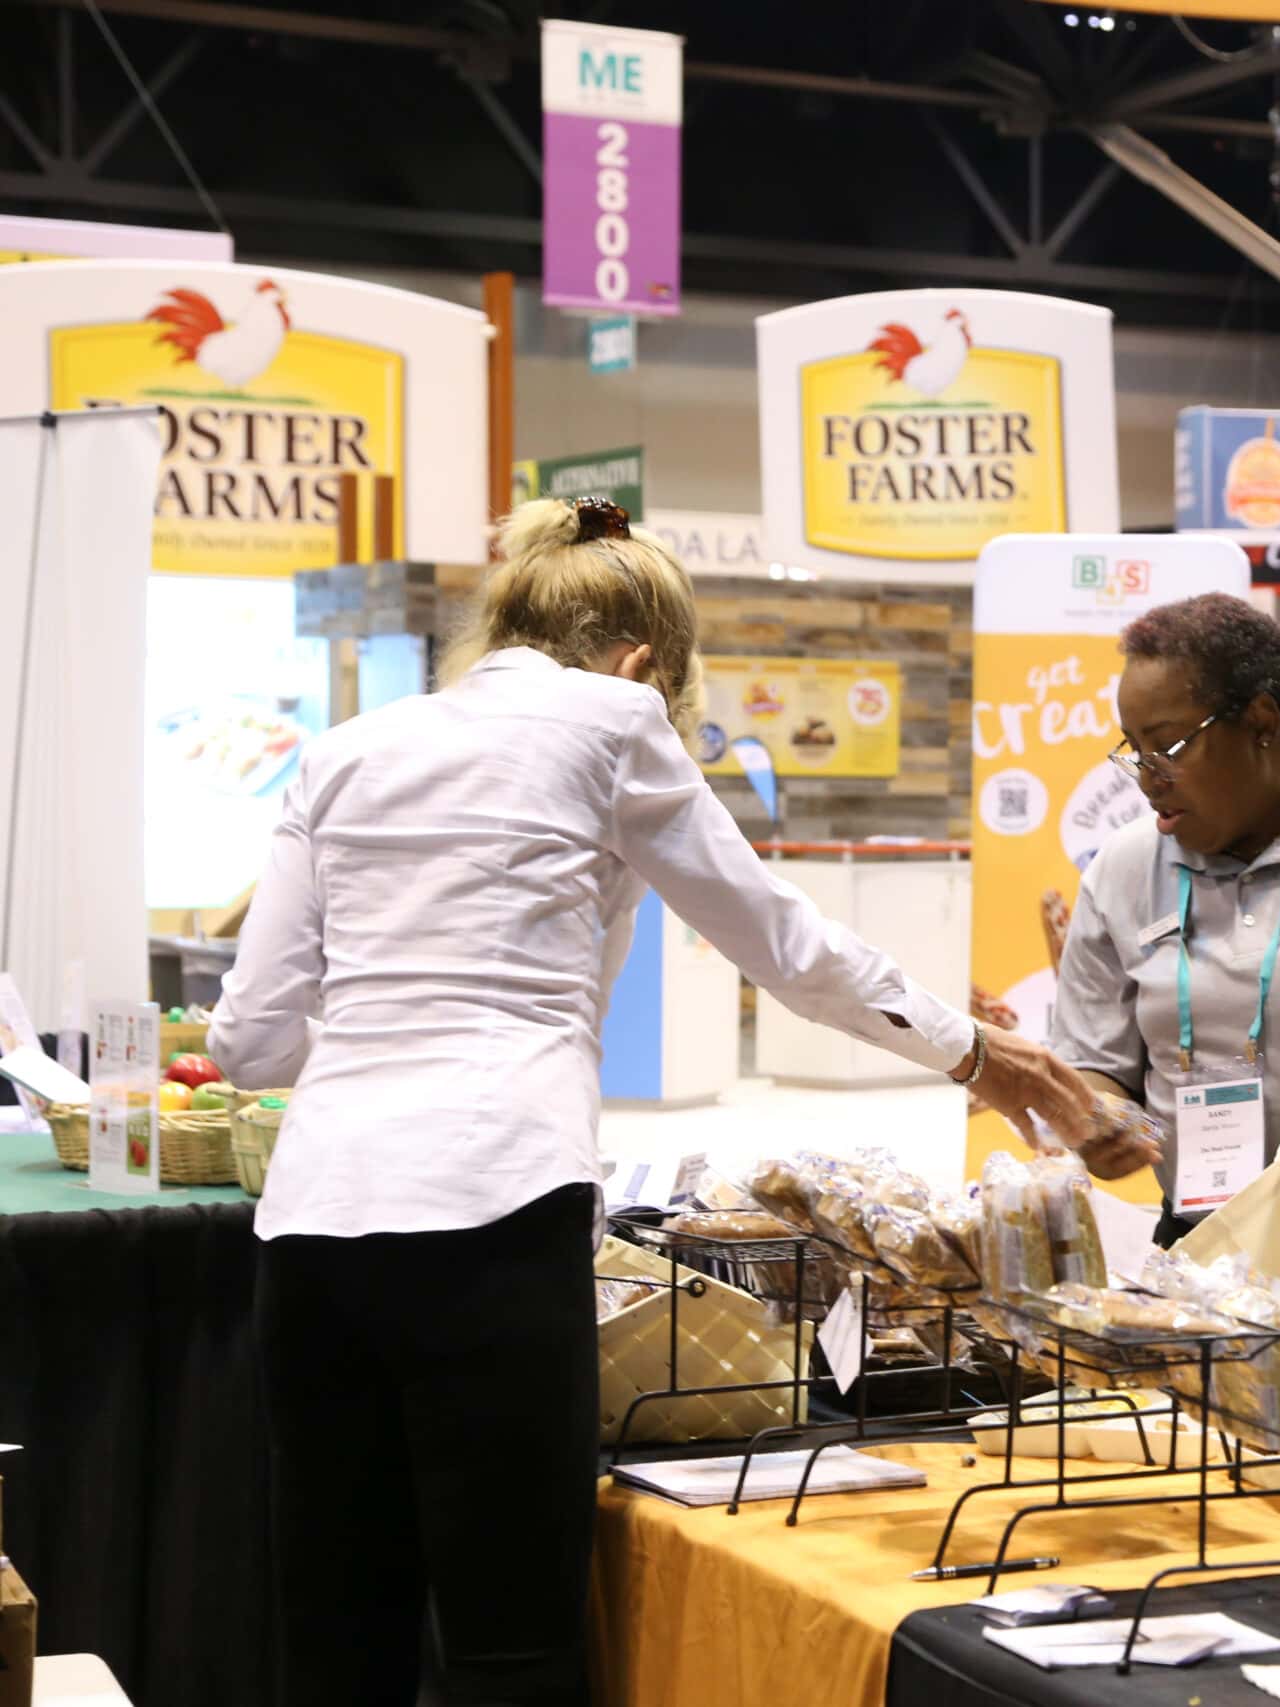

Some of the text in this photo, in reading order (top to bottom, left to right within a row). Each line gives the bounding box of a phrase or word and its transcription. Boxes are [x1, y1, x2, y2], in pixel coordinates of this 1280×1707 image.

[579, 50, 642, 93] ME
[595, 121, 630, 302] 2800
[162, 404, 369, 467] STER
[823, 412, 1035, 459] FOSTER
[153, 468, 340, 526] ARMS
[848, 462, 1016, 502] FARMS
[1026, 656, 1085, 706] get
